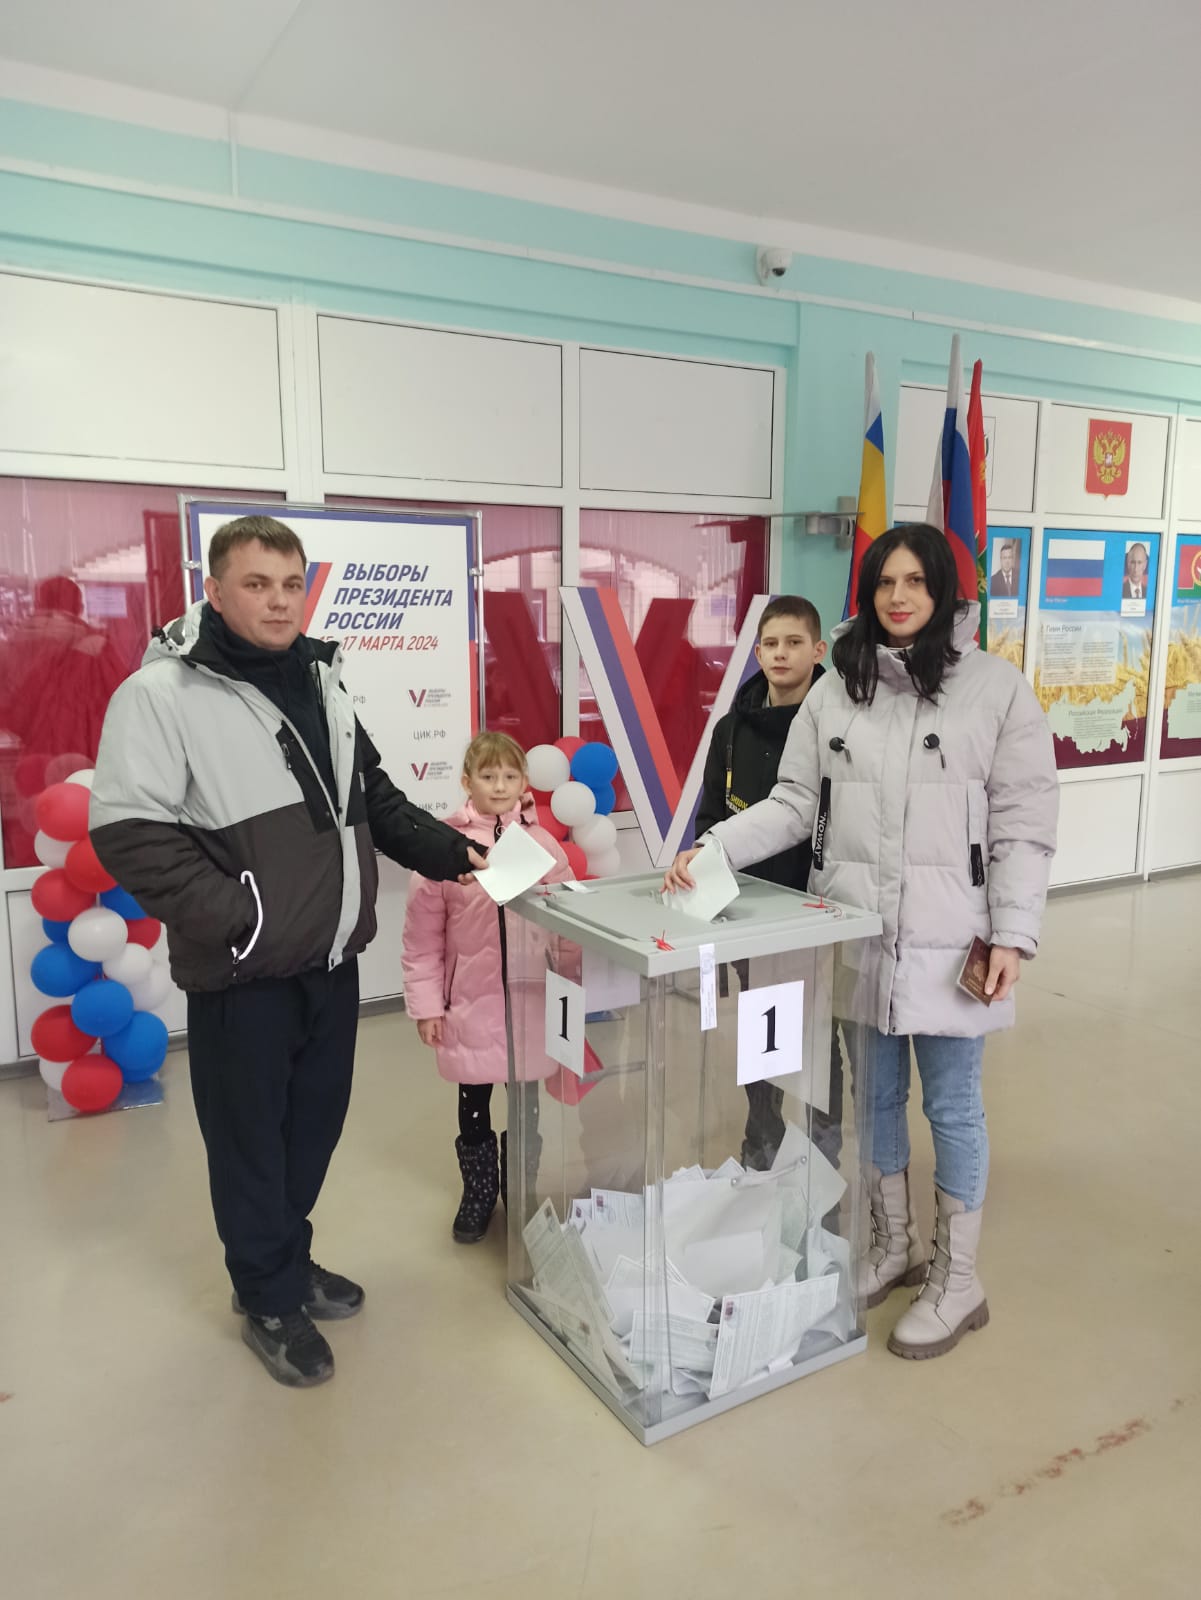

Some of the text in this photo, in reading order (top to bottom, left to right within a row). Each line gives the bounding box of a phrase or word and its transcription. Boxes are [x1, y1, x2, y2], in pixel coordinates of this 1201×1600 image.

[343, 563, 429, 582] ВЫБОРЫ
[333, 588, 453, 608] ПРЕЗИДЕНТА
[324, 612, 404, 630] РОССИИ
[358, 636, 405, 651] МАРТА
[407, 636, 439, 651] 2024
[353, 695, 366, 704] РФ
[413, 730, 446, 741] ЦИК РФ
[435, 802, 448, 811] РФ
[559, 995, 570, 1042] 1
[760, 1005, 781, 1055] 1
